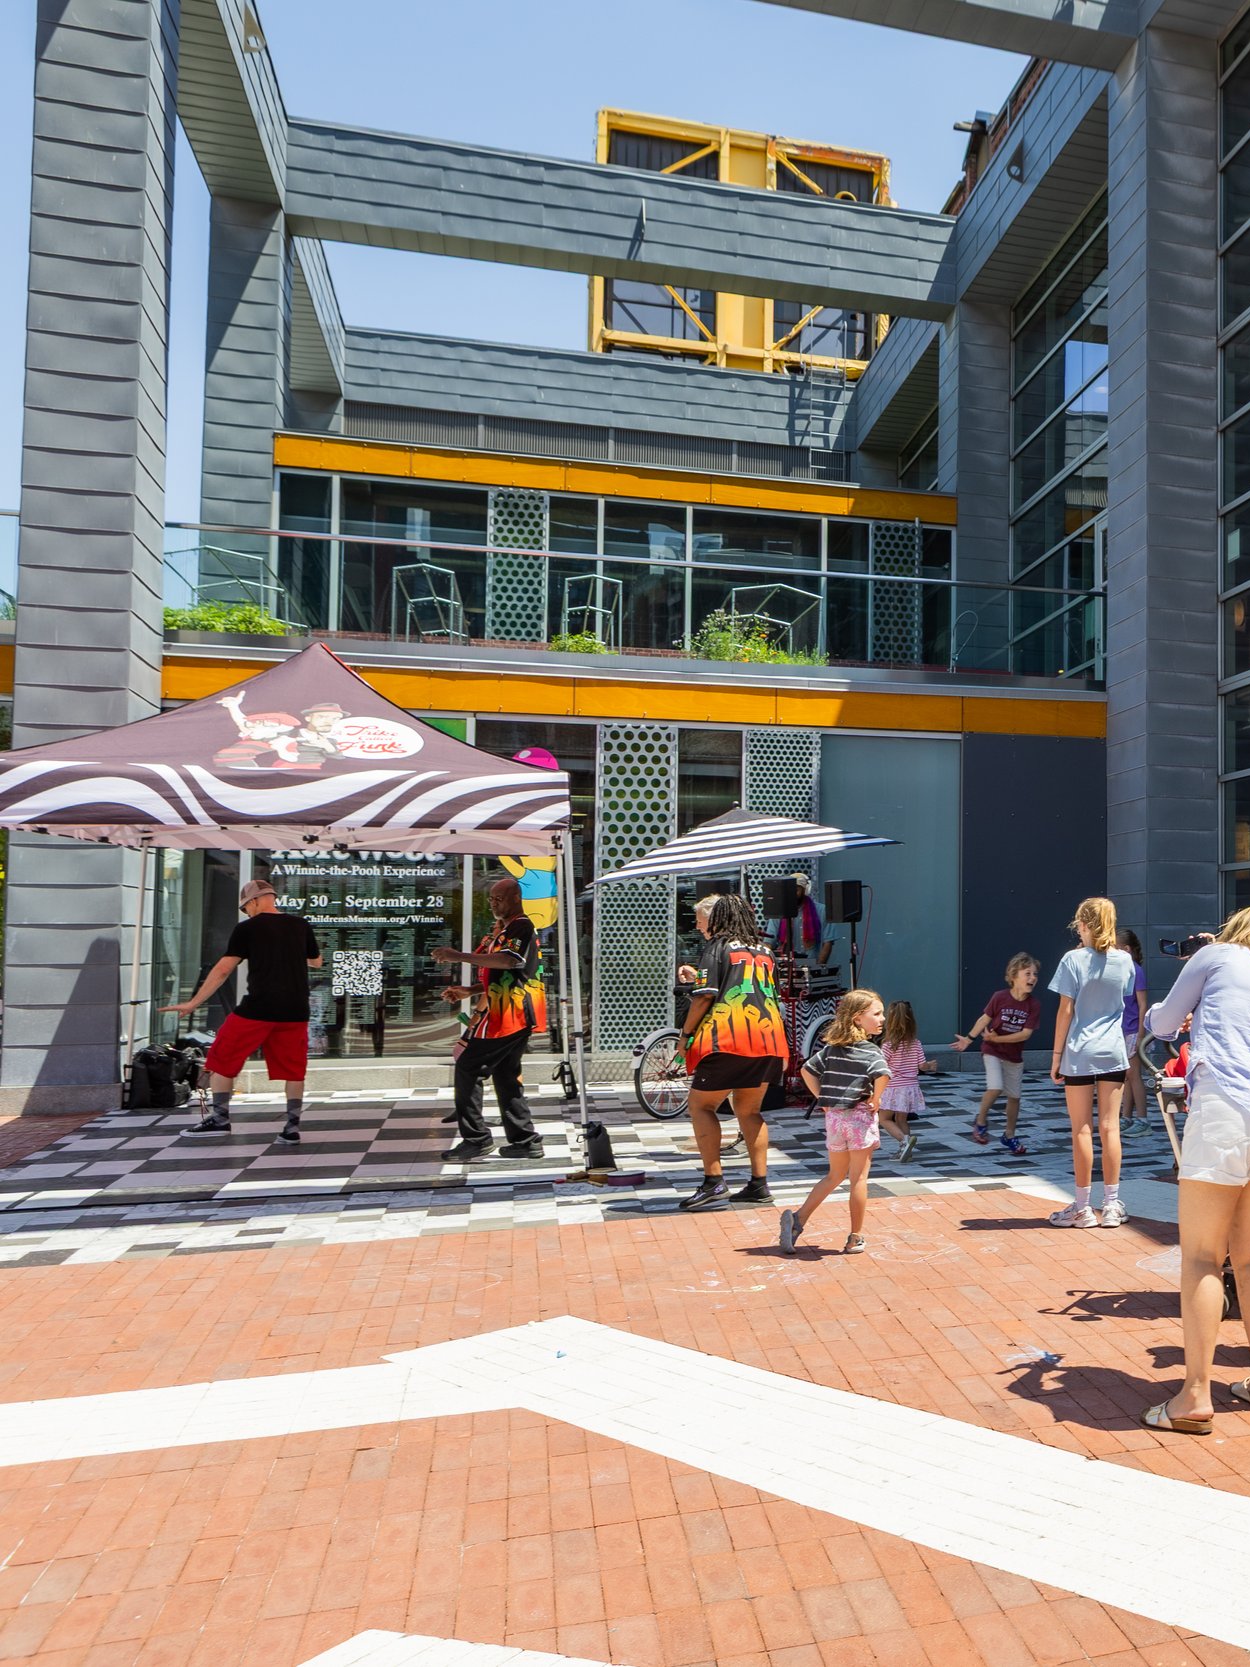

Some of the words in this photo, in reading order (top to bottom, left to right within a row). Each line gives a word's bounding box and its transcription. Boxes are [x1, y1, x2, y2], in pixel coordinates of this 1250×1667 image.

[270, 864, 283, 876] A
[283, 864, 381, 876] Winnie-the-Pooh
[383, 865, 446, 879] Experience
[273, 894, 306, 910] May
[310, 895, 328, 908] 30
[345, 895, 423, 910] September
[426, 895, 444, 908] 28
[729, 951, 775, 998] 70
